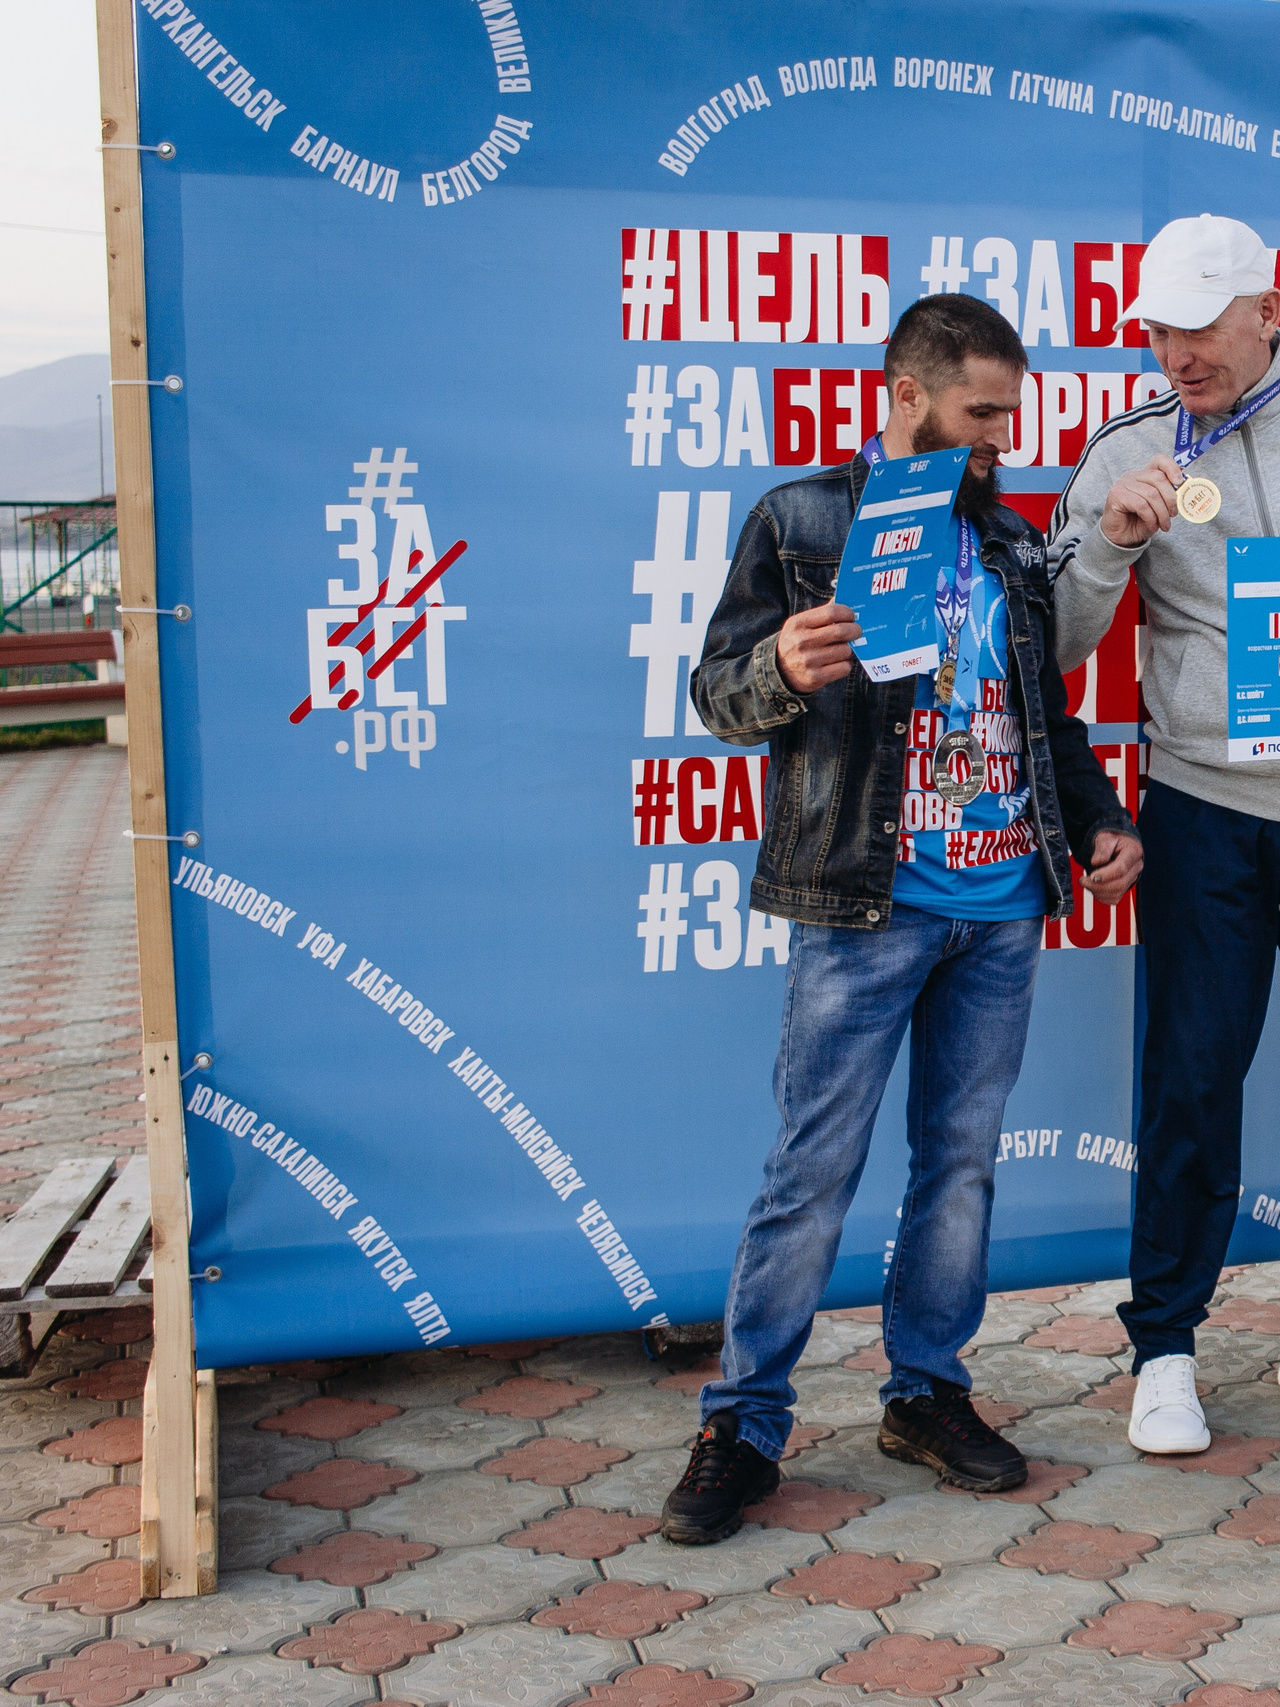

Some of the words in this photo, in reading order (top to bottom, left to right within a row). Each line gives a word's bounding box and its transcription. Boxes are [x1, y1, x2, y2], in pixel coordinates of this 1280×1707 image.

[471, 0, 532, 93] ВЕЛИКИ
[422, 114, 533, 207] БЕЛГОРОД
[658, 75, 772, 177] ВОЛГОГРАД
[779, 56, 877, 98] ВОЛОГДА
[893, 56, 994, 97] ВОРОНЕЖ
[1010, 71, 1094, 115] ГАТЧИНА
[1110, 90, 1259, 153] ГОРНО-АЛТАЙСК
[290, 125, 400, 202] БАРНАУЛ
[622, 228, 891, 345] #ЦЕЛЬ
[920, 236, 1150, 348] #ЗАБ
[1218, 410, 1250, 436] ОБЛАСТЬ
[325, 504, 446, 606] ЗА
[882, 525, 924, 556] МЕСТО
[960, 525, 971, 568] ОБЛАСТЬ
[307, 606, 467, 710] БЕГ
[902, 656, 923, 669] FONBET
[173, 856, 297, 937] УЛЬЯНОВСК
[297, 922, 347, 970] УФА
[346, 957, 455, 1054] ХАБАРОВСК
[447, 1046, 586, 1201] ХАНТЫ-МАНСИЙСК
[576, 1199, 658, 1312] ЧЕЛЯБИНСК
[996, 1130, 1063, 1162] РБУРГ
[1076, 1132, 1139, 1173] САРАН
[187, 1083, 358, 1220] ЮЖНО-САХАЛИНСК
[348, 1215, 417, 1292] ЯКУТСК
[403, 1291, 451, 1345] ЯЛТА
